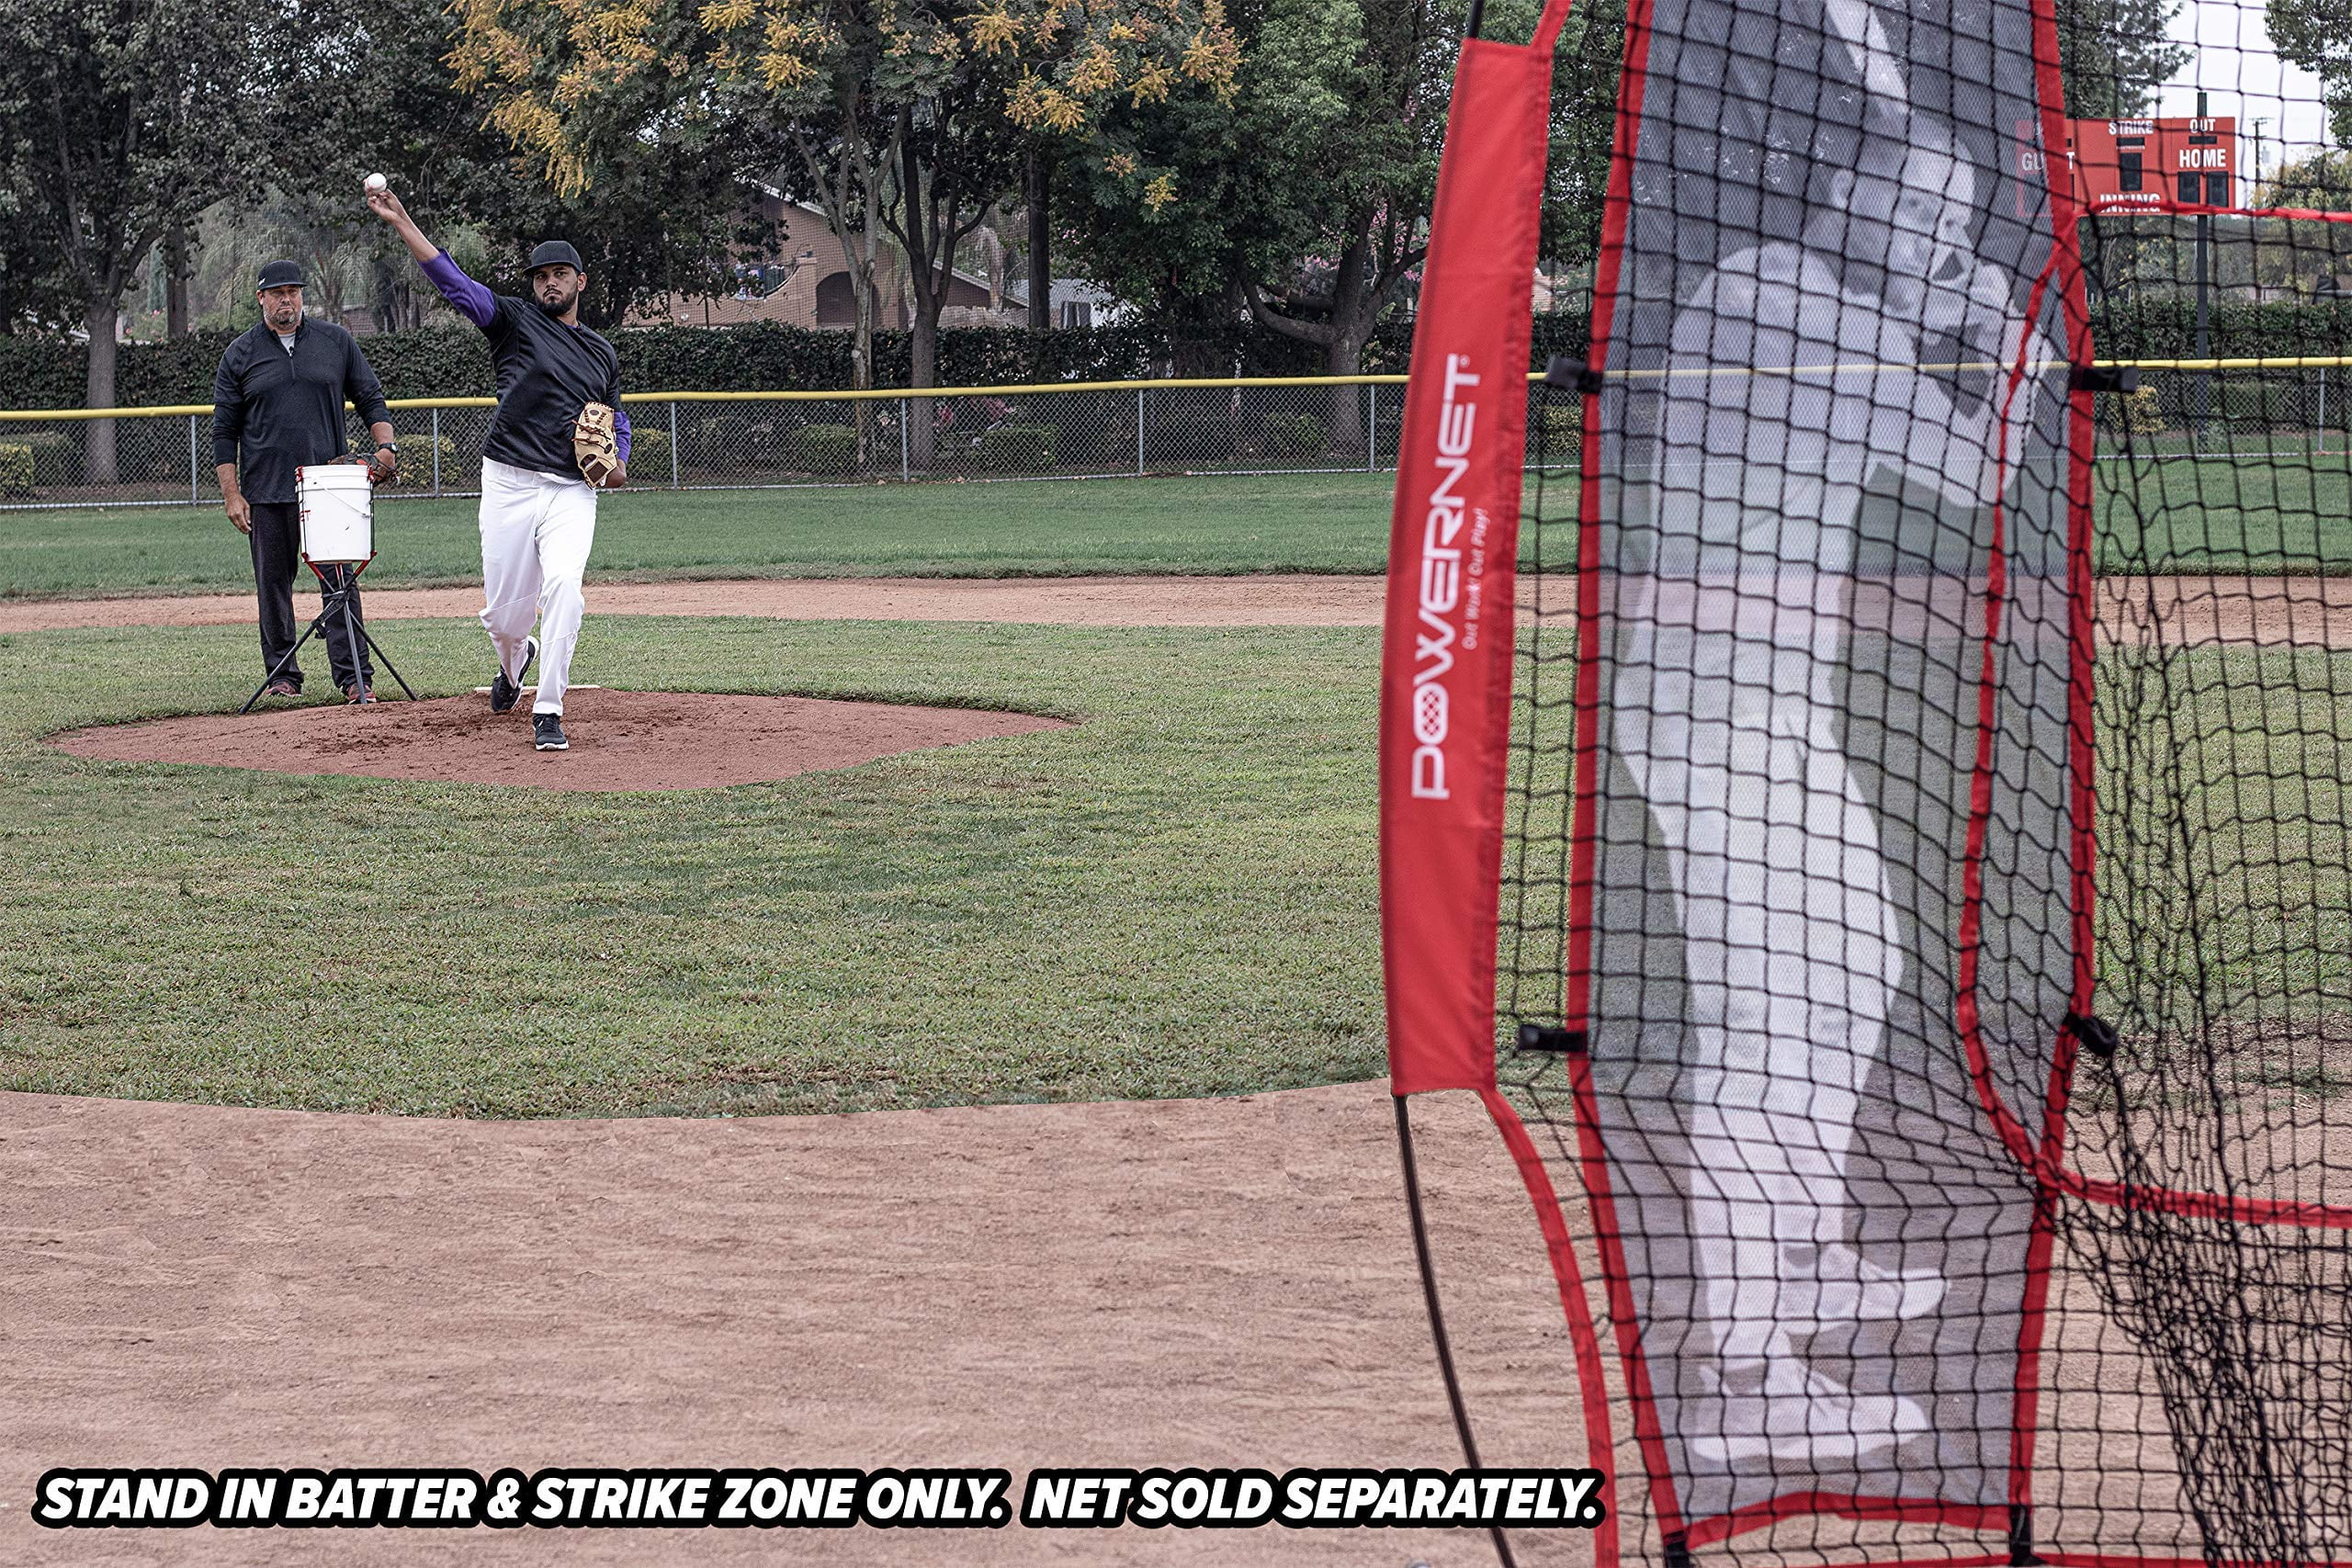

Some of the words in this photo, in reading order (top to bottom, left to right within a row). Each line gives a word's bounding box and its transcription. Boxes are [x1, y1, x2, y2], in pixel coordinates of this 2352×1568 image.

[2109, 120, 2154, 135] STRIKE
[2189, 118, 2216, 133] OUT
[2022, 152, 2075, 171] GUT
[2179, 149, 2226, 168] HOME
